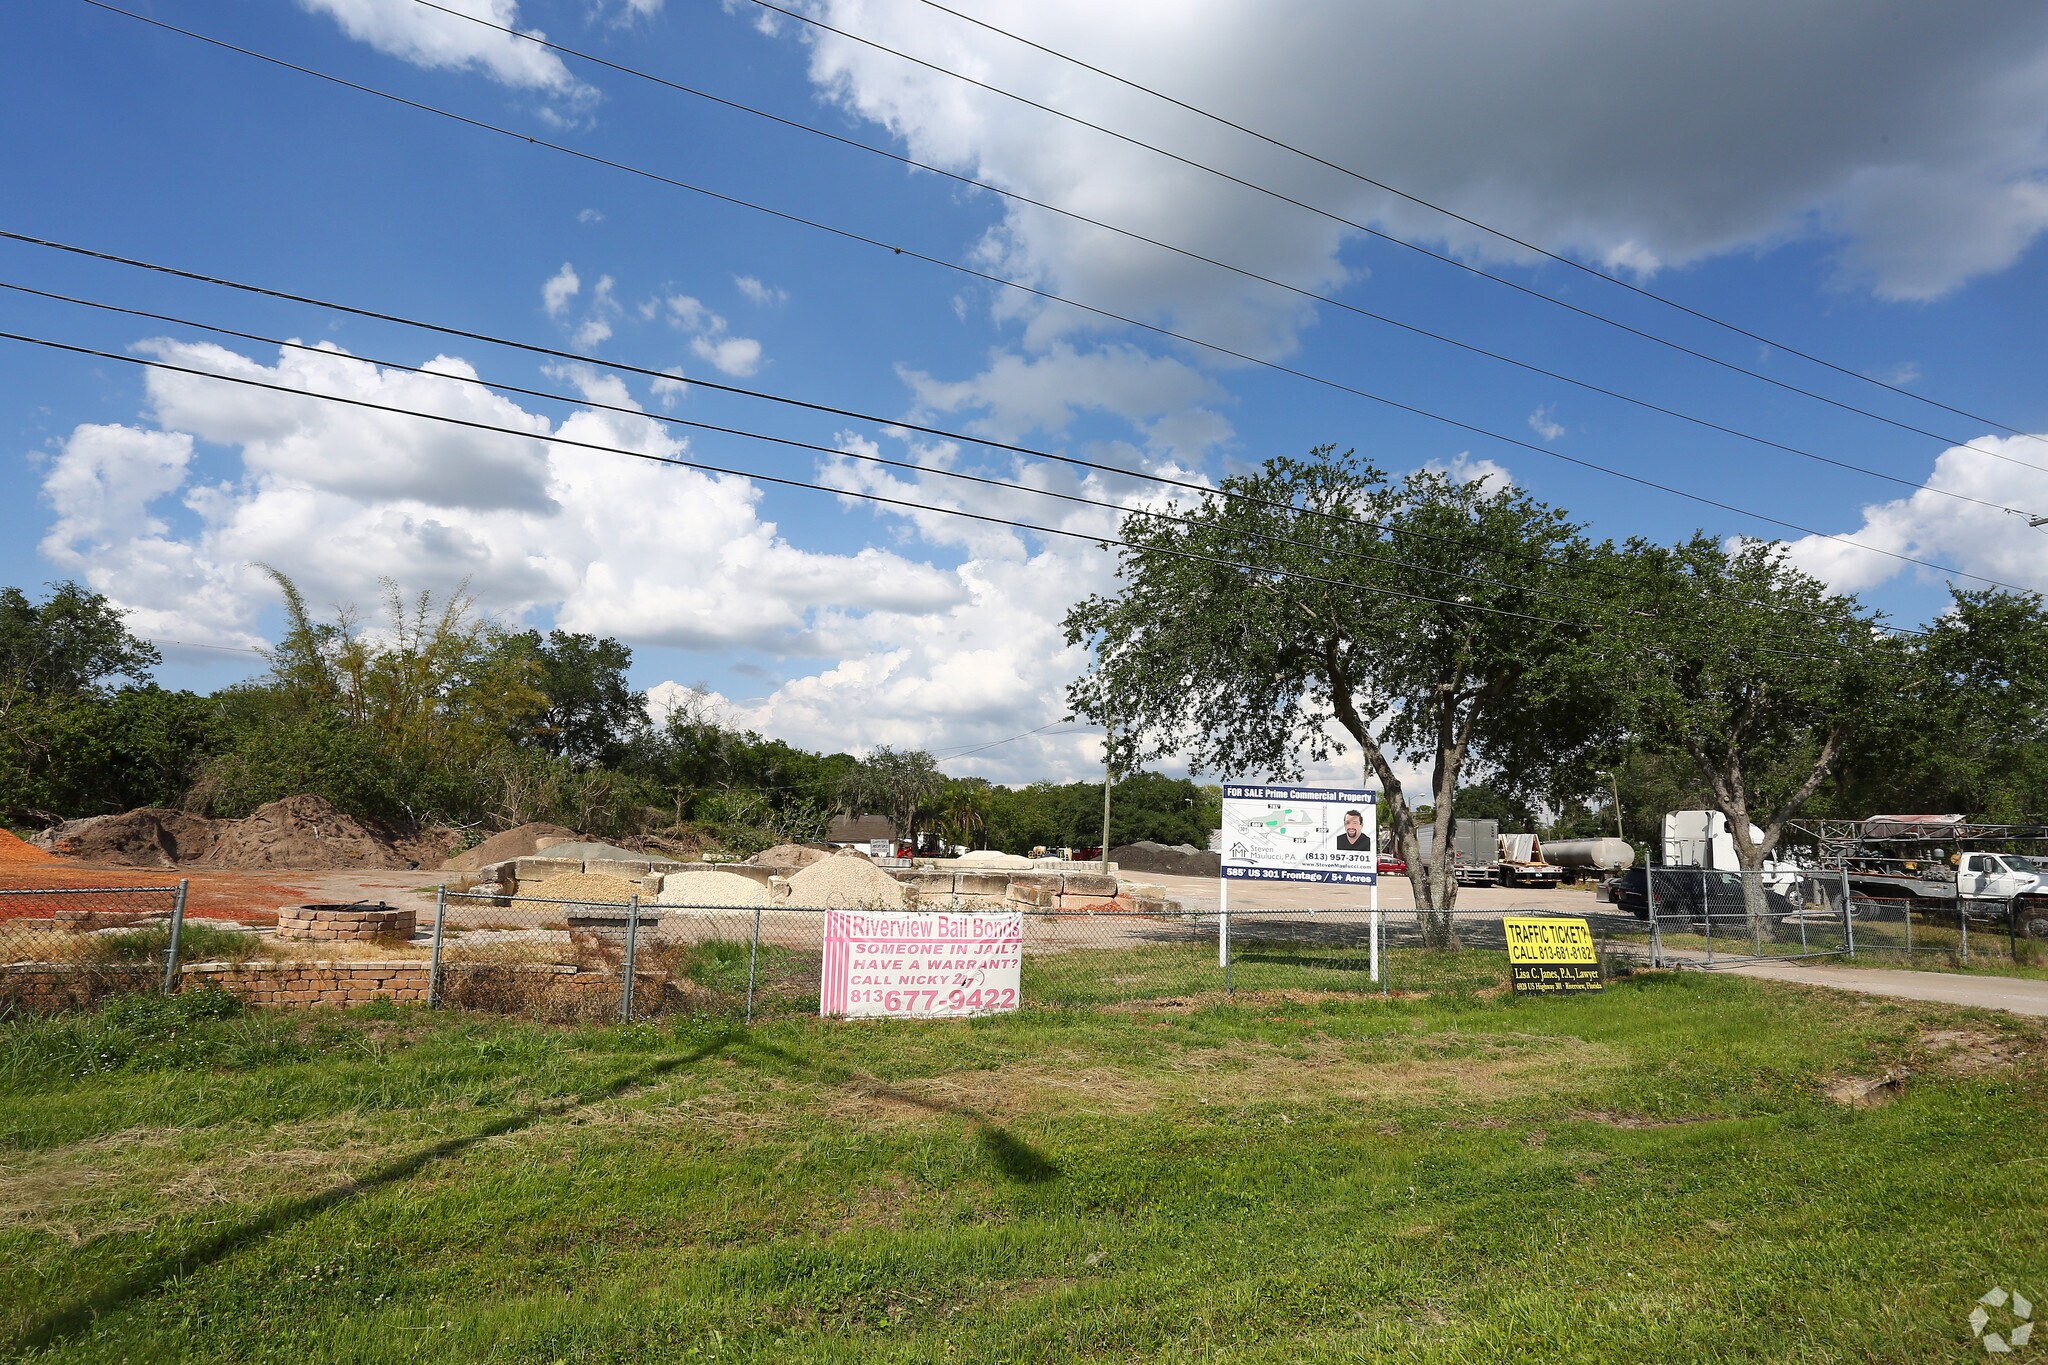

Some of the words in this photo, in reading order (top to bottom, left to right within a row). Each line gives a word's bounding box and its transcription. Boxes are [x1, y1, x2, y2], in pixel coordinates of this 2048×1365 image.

[1227, 788, 1242, 797] FOR
[1244, 788, 1264, 798] SALE
[1265, 789, 1288, 798] Prime
[1290, 790, 1336, 800] Commercial
[1338, 792, 1372, 803] Property
[1250, 852, 1284, 860] Maulucci,
[1306, 852, 1328, 861] (813)
[1330, 854, 1370, 862] 957-3701
[1226, 868, 1246, 876] 585'
[1248, 869, 1260, 877] US
[1262, 870, 1280, 878] 301
[1282, 871, 1321, 882] Frontage
[1331, 874, 1343, 882] 5+
[1345, 874, 1371, 883] Acres
[853, 915, 933, 938] Riverview
[938, 916, 967, 938] Bail
[973, 916, 1020, 938] Bonds
[1508, 924, 1549, 943] TRAFFIC
[1549, 925, 1587, 944] TICKET?
[855, 943, 943, 955] SOMEONE
[950, 944, 968, 955] IN
[973, 944, 1018, 955] JAIL?
[1513, 946, 1538, 959] CALL
[1539, 946, 1592, 960] 813-681-8182
[853, 959, 903, 970] HAVE
[908, 959, 920, 970] A
[928, 959, 1018, 970] WARRANT?
[851, 975, 896, 985] CALL
[899, 975, 950, 985] NICKY
[1514, 968, 1530, 979] Lisa
[1531, 968, 1540, 979] C.
[1575, 968, 1599, 981] Lawyer
[1535, 983, 1554, 992] Highway
[851, 990, 883, 1003] 813
[884, 988, 1015, 1011] 677-9422
